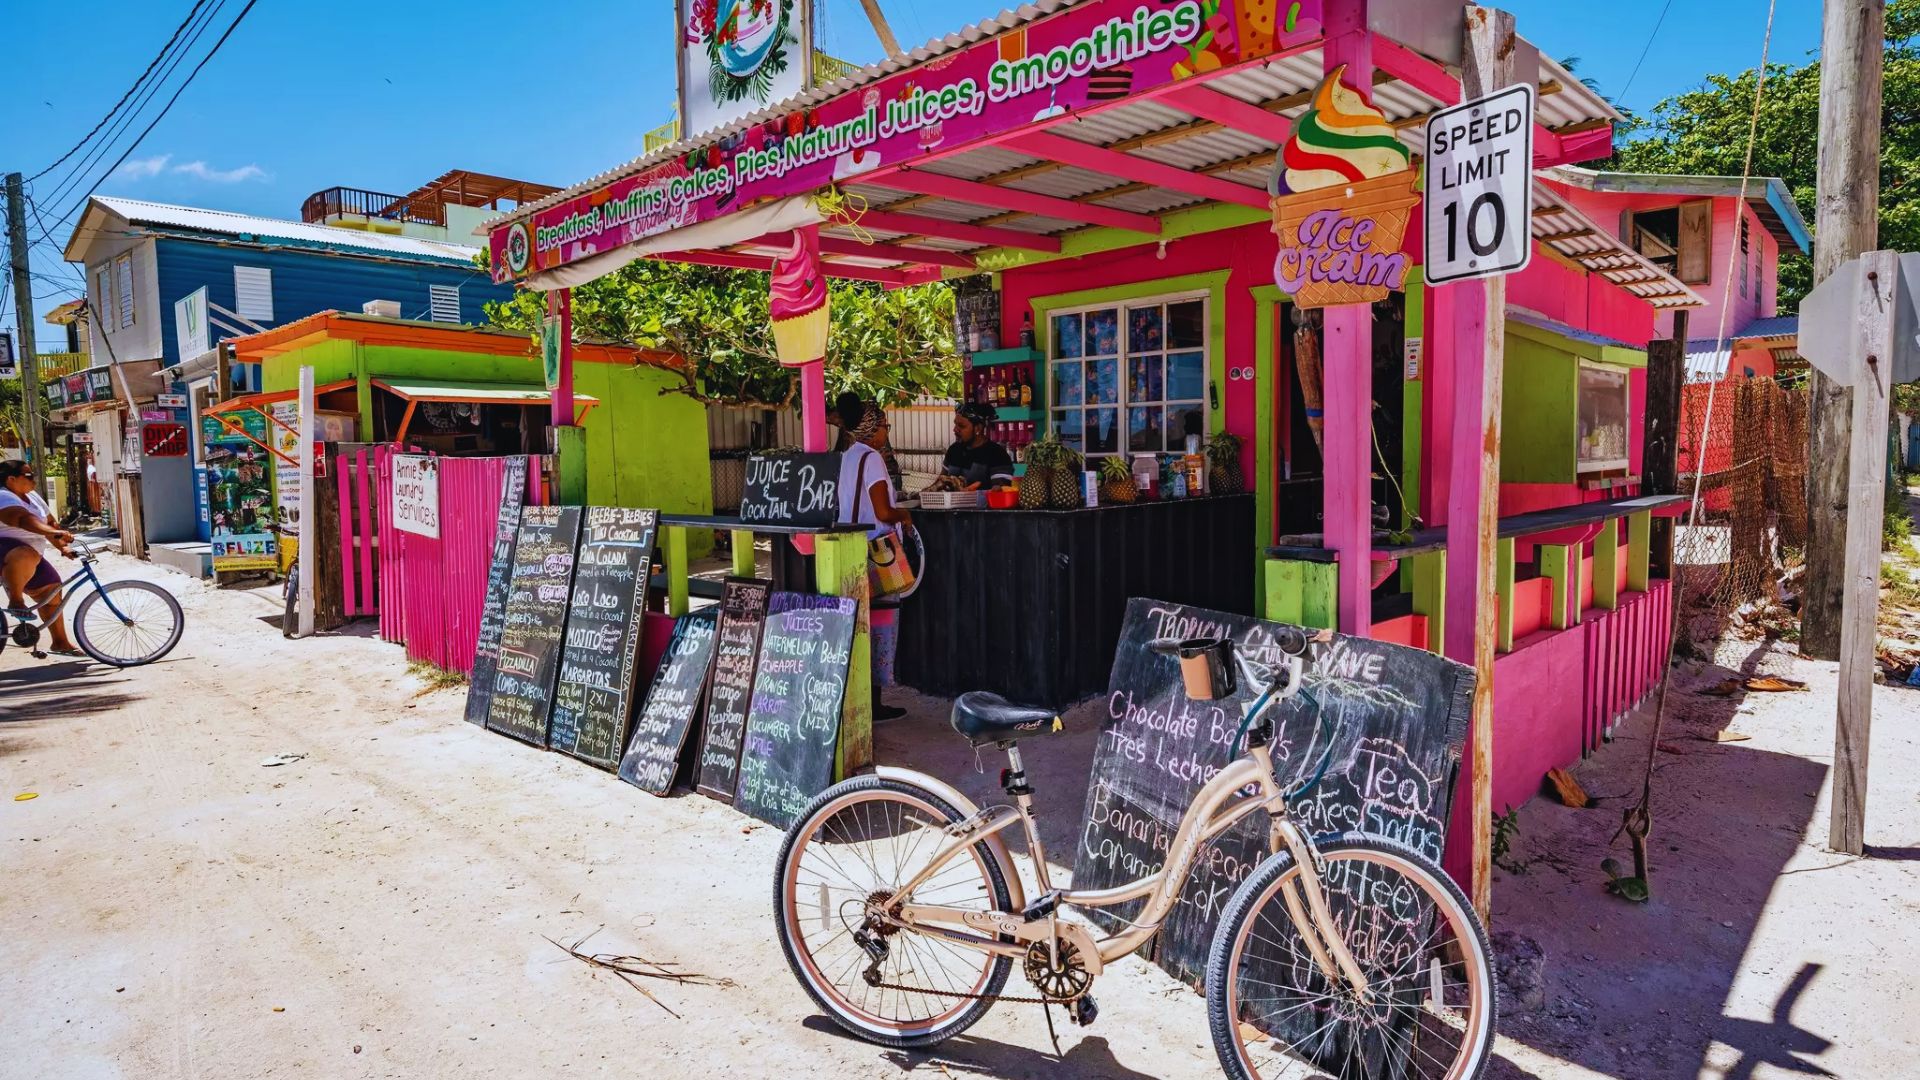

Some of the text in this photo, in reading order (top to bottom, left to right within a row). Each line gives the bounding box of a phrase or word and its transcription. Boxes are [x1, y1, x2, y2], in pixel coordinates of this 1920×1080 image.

[537, 213, 603, 251] Breakfast,
[605, 189, 668, 228] Muffins,
[670, 165, 735, 204] Cakes,
[879, 78, 985, 138] Juices,
[988, 1, 1200, 101] Smoothies
[1433, 107, 1522, 156] SPEED
[1441, 149, 1510, 190] LIMIT
[1298, 208, 1377, 252] Ice
[1444, 191, 1506, 263] 10
[1274, 246, 1405, 295] Cream
[145, 427, 185, 440] DIVE
[145, 441, 186, 455] SHOP
[746, 456, 792, 486] JUICE
[796, 464, 835, 513] BAR
[740, 497, 792, 520] COCKTAIL
[213, 540, 276, 556] BELIZE
[597, 544, 628, 565] COLADA
[781, 612, 824, 632] JUICES
[566, 627, 601, 649] MOJITO
[669, 637, 700, 658] COLD
[764, 626, 849, 665] WATERMELON Beets
[560, 660, 611, 688] MARGARITAS
[759, 650, 804, 674] PINEAPPLE
[497, 672, 519, 695] COMBO
[520, 681, 547, 702] SPECIAL
[649, 684, 687, 702] BELIKIN
[755, 672, 790, 696] ORANGE
[807, 675, 838, 698] CREATE
[752, 694, 787, 714] CARROT
[808, 694, 832, 714] YOUR
[1109, 690, 1198, 739] Chocolate
[747, 711, 791, 744] CUCUMBER
[805, 712, 831, 732] MIX
[744, 733, 773, 757] APPLE
[741, 750, 767, 775] LIME
[1357, 748, 1420, 811] Tea
